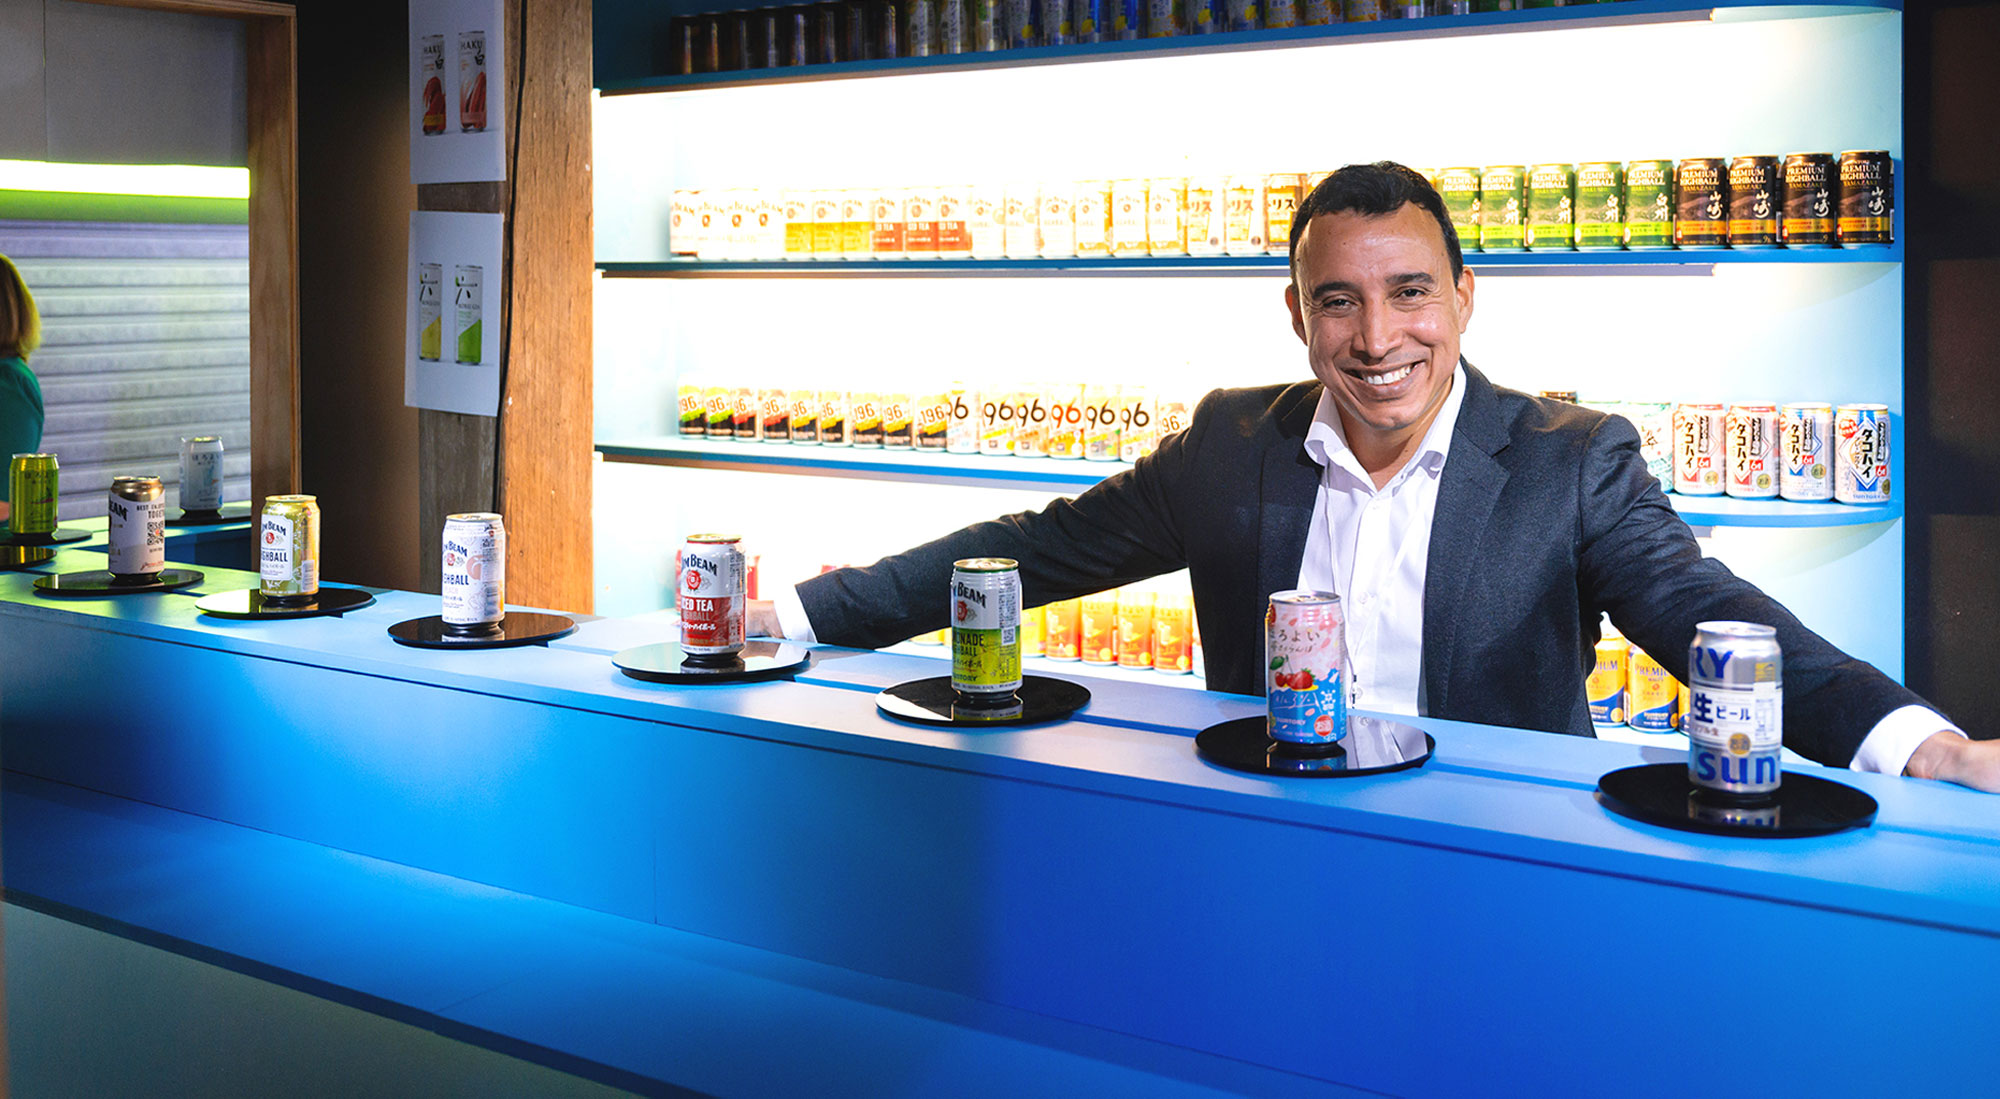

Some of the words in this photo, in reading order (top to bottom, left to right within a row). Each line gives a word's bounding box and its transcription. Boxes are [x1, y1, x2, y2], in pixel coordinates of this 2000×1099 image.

[1681, 169, 1718, 178] PREMIUM
[1730, 168, 1765, 177] PREMIUM
[1787, 166, 1825, 175] PREMIUM
[1841, 164, 1880, 173] PREMIUM
[1680, 177, 1719, 186] HIGHBALL
[1729, 176, 1767, 185] HIGHBALL
[1785, 174, 1826, 183] HIGHBALL
[1840, 172, 1881, 181] HIGHBALL
[1186, 201, 1213, 212] リス
[1227, 200, 1254, 212] リス
[1268, 199, 1297, 211] リス
[1684, 421, 1695, 469] タコハイ
[1736, 423, 1747, 472] タコハイ
[1791, 424, 1800, 465] タコハイ
[1862, 428, 1873, 478] タコハイ
[268, 520, 287, 536] BEAM
[448, 540, 468, 557] BEAM
[690, 553, 718, 576] BEAM
[957, 581, 987, 609] BEAM
[696, 599, 714, 612] TEA
